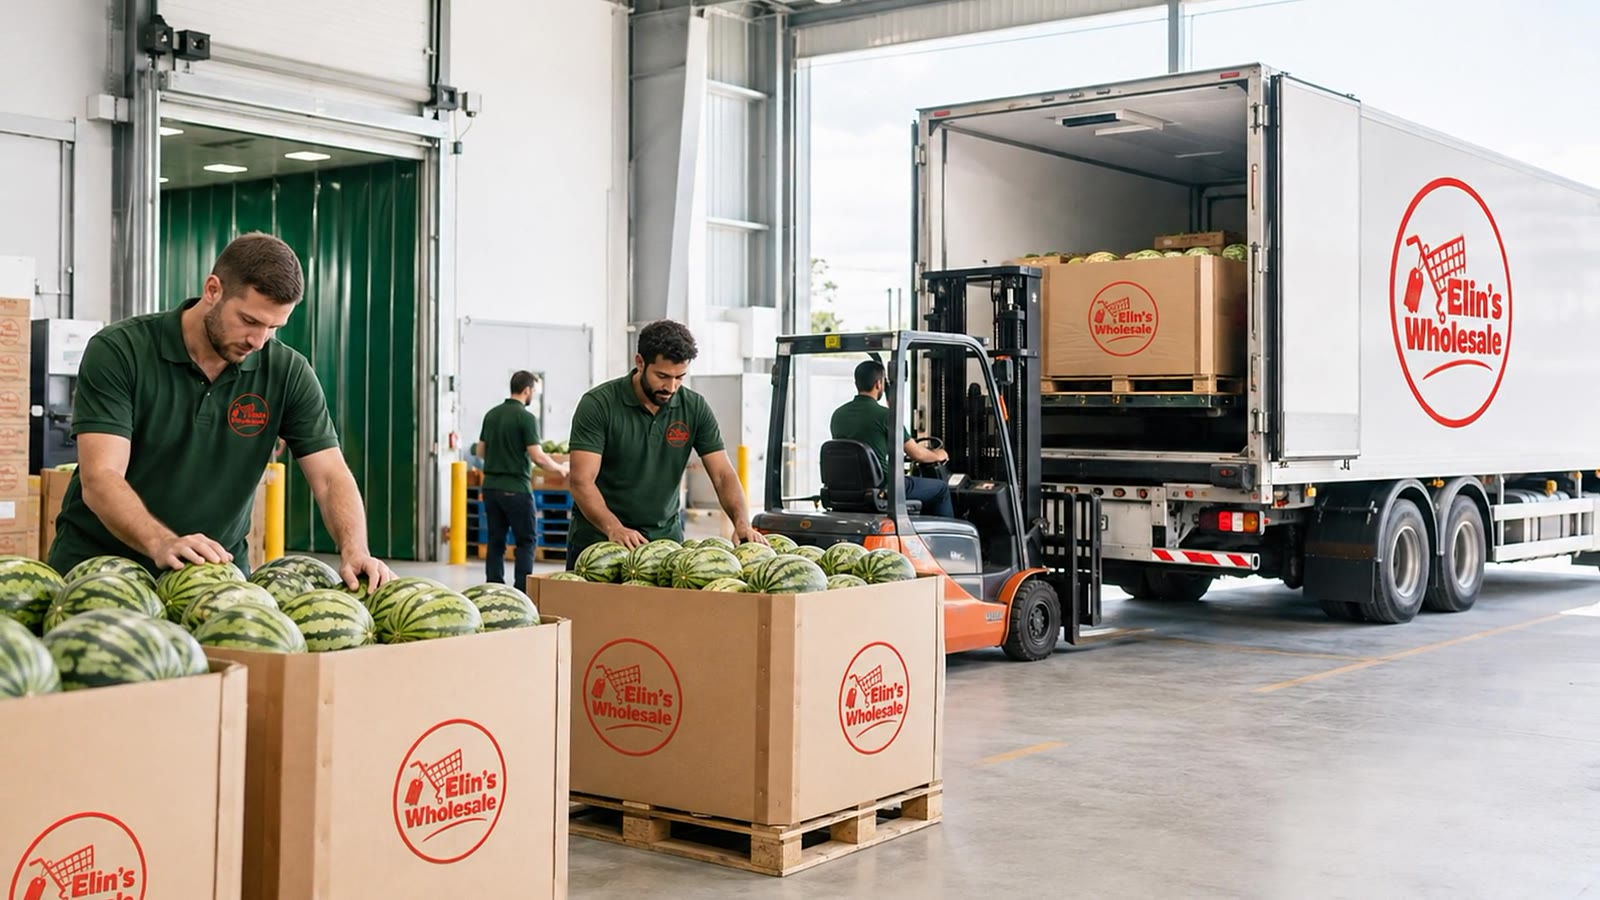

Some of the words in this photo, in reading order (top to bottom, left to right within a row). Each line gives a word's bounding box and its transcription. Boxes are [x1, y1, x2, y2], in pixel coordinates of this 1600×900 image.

[1447, 277, 1503, 320] Elin's
[1095, 323, 1152, 335] Wholesale
[1404, 316, 1502, 356] Wholesale
[624, 685, 673, 708] Elin's
[871, 682, 904, 704] Elin's
[591, 699, 672, 726] Wholesale
[845, 700, 903, 727] Wholesale
[445, 769, 497, 799] Elin's
[404, 793, 497, 829] Wholesale
[71, 866, 136, 898] Elin's
